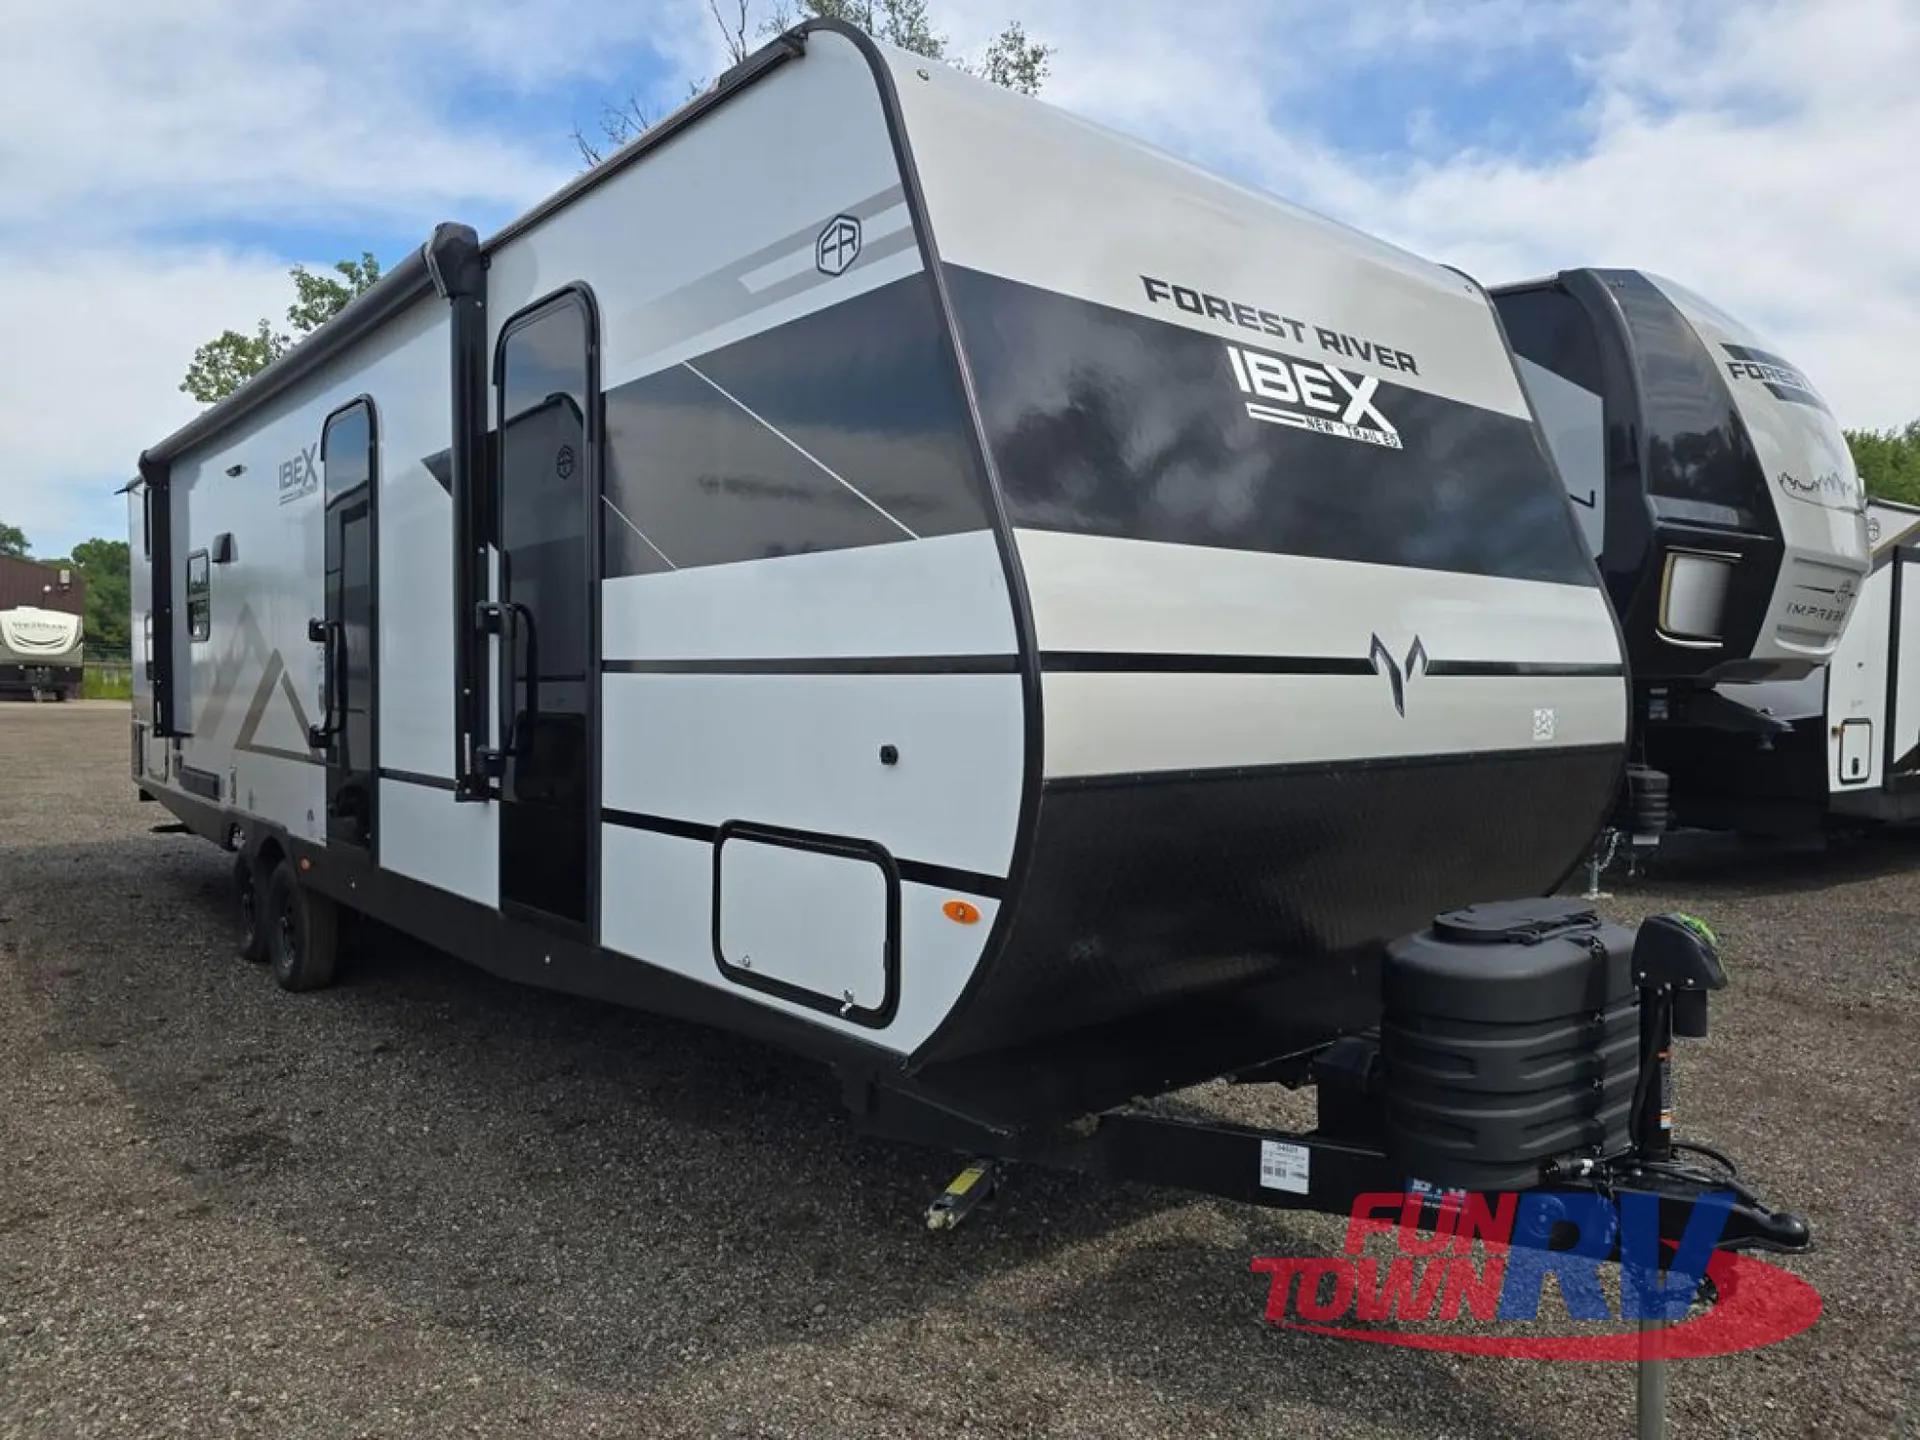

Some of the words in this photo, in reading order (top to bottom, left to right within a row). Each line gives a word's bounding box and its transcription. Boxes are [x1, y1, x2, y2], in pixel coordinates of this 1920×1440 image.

[1140, 275, 1306, 343] FOREST
[1314, 326, 1420, 376] RIVER
[1227, 346, 1397, 432] IBEX
[1306, 414, 1335, 434] NEW
[278, 442, 318, 490] IBEX
